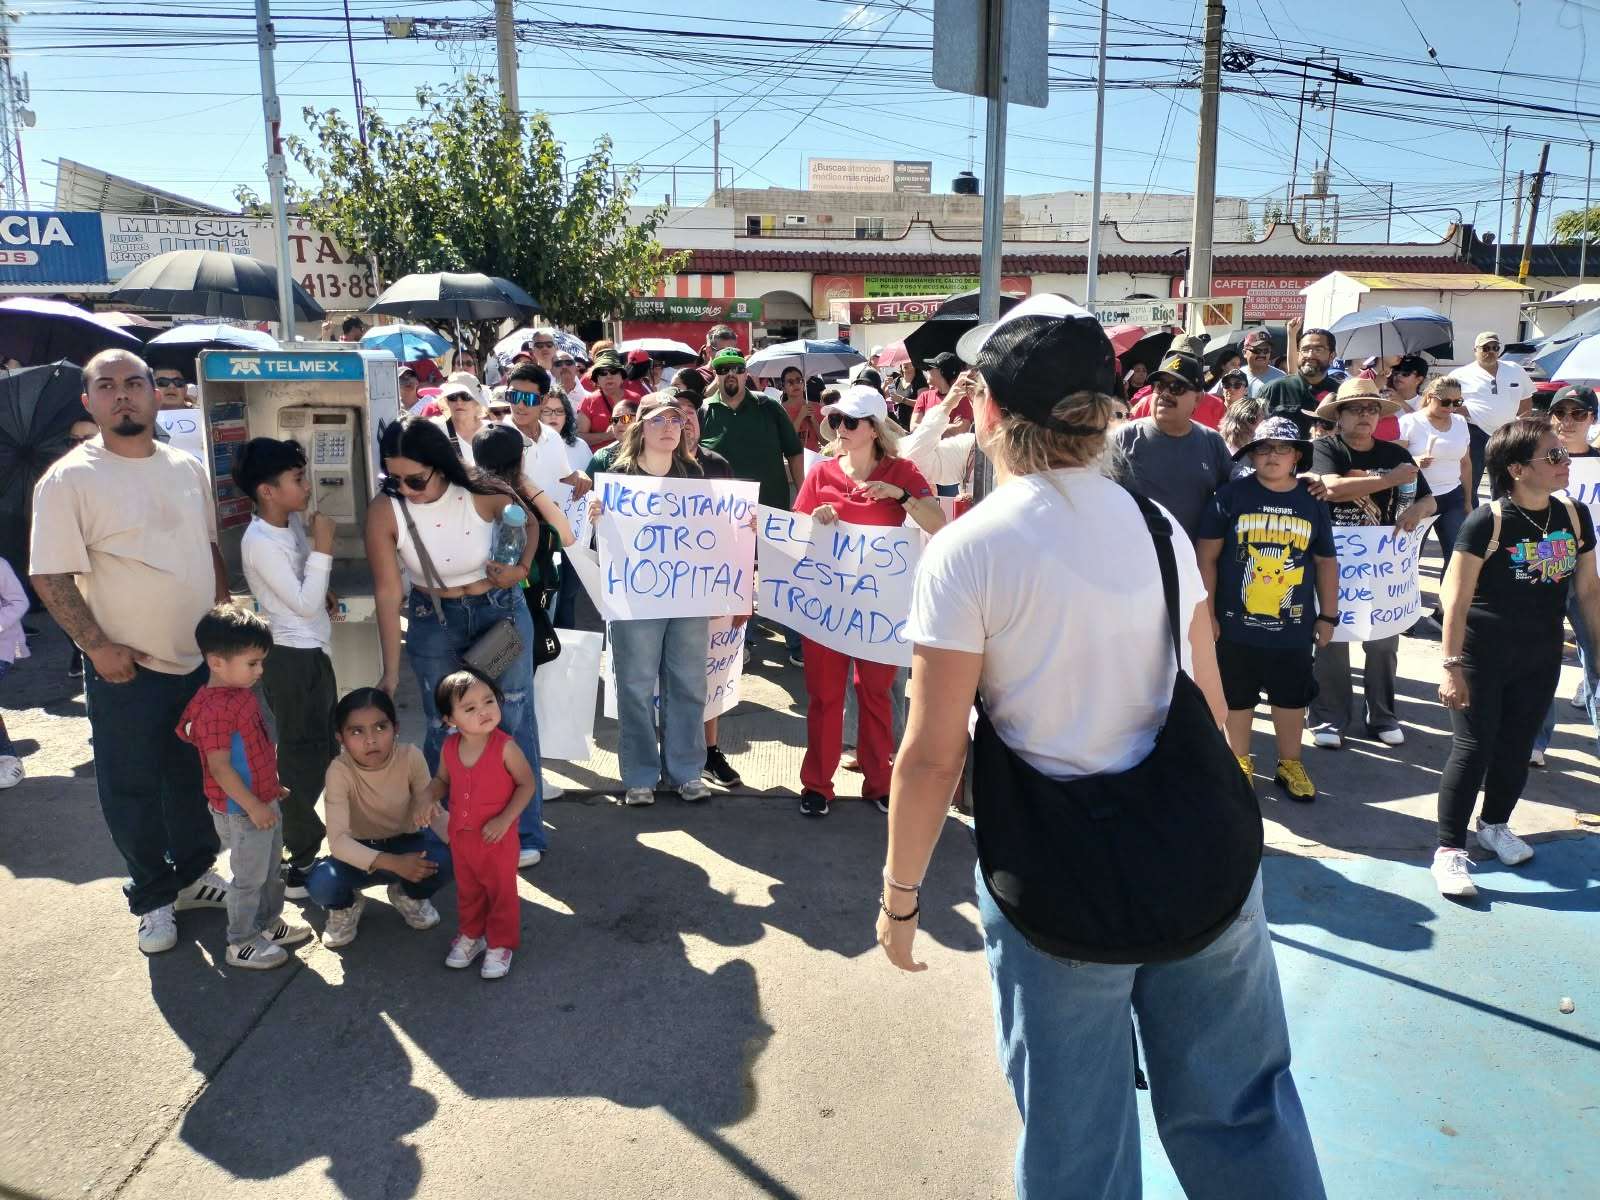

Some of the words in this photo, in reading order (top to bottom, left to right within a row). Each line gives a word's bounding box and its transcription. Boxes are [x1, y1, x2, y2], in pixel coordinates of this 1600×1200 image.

[0, 215, 74, 246] CIA
[118, 217, 190, 234] MINI
[1214, 280, 1275, 289] CAFETERIA
[1280, 281, 1301, 289] DEL
[670, 305, 682, 314] NO
[684, 306, 701, 314] VAN
[876, 301, 943, 317] ELOT
[1095, 310, 1118, 322] otes
[265, 360, 339, 372] TELMEX
[600, 482, 756, 529] NECESITAMOS
[634, 525, 717, 554] OTRO
[1237, 513, 1312, 551] PIKACHU
[765, 513, 815, 546] EL
[833, 531, 909, 577] IMSS
[1511, 539, 1577, 562] JESUS
[608, 557, 745, 601] HOSPITAL
[792, 556, 880, 599] ESTA
[1338, 561, 1394, 580] ORIR
